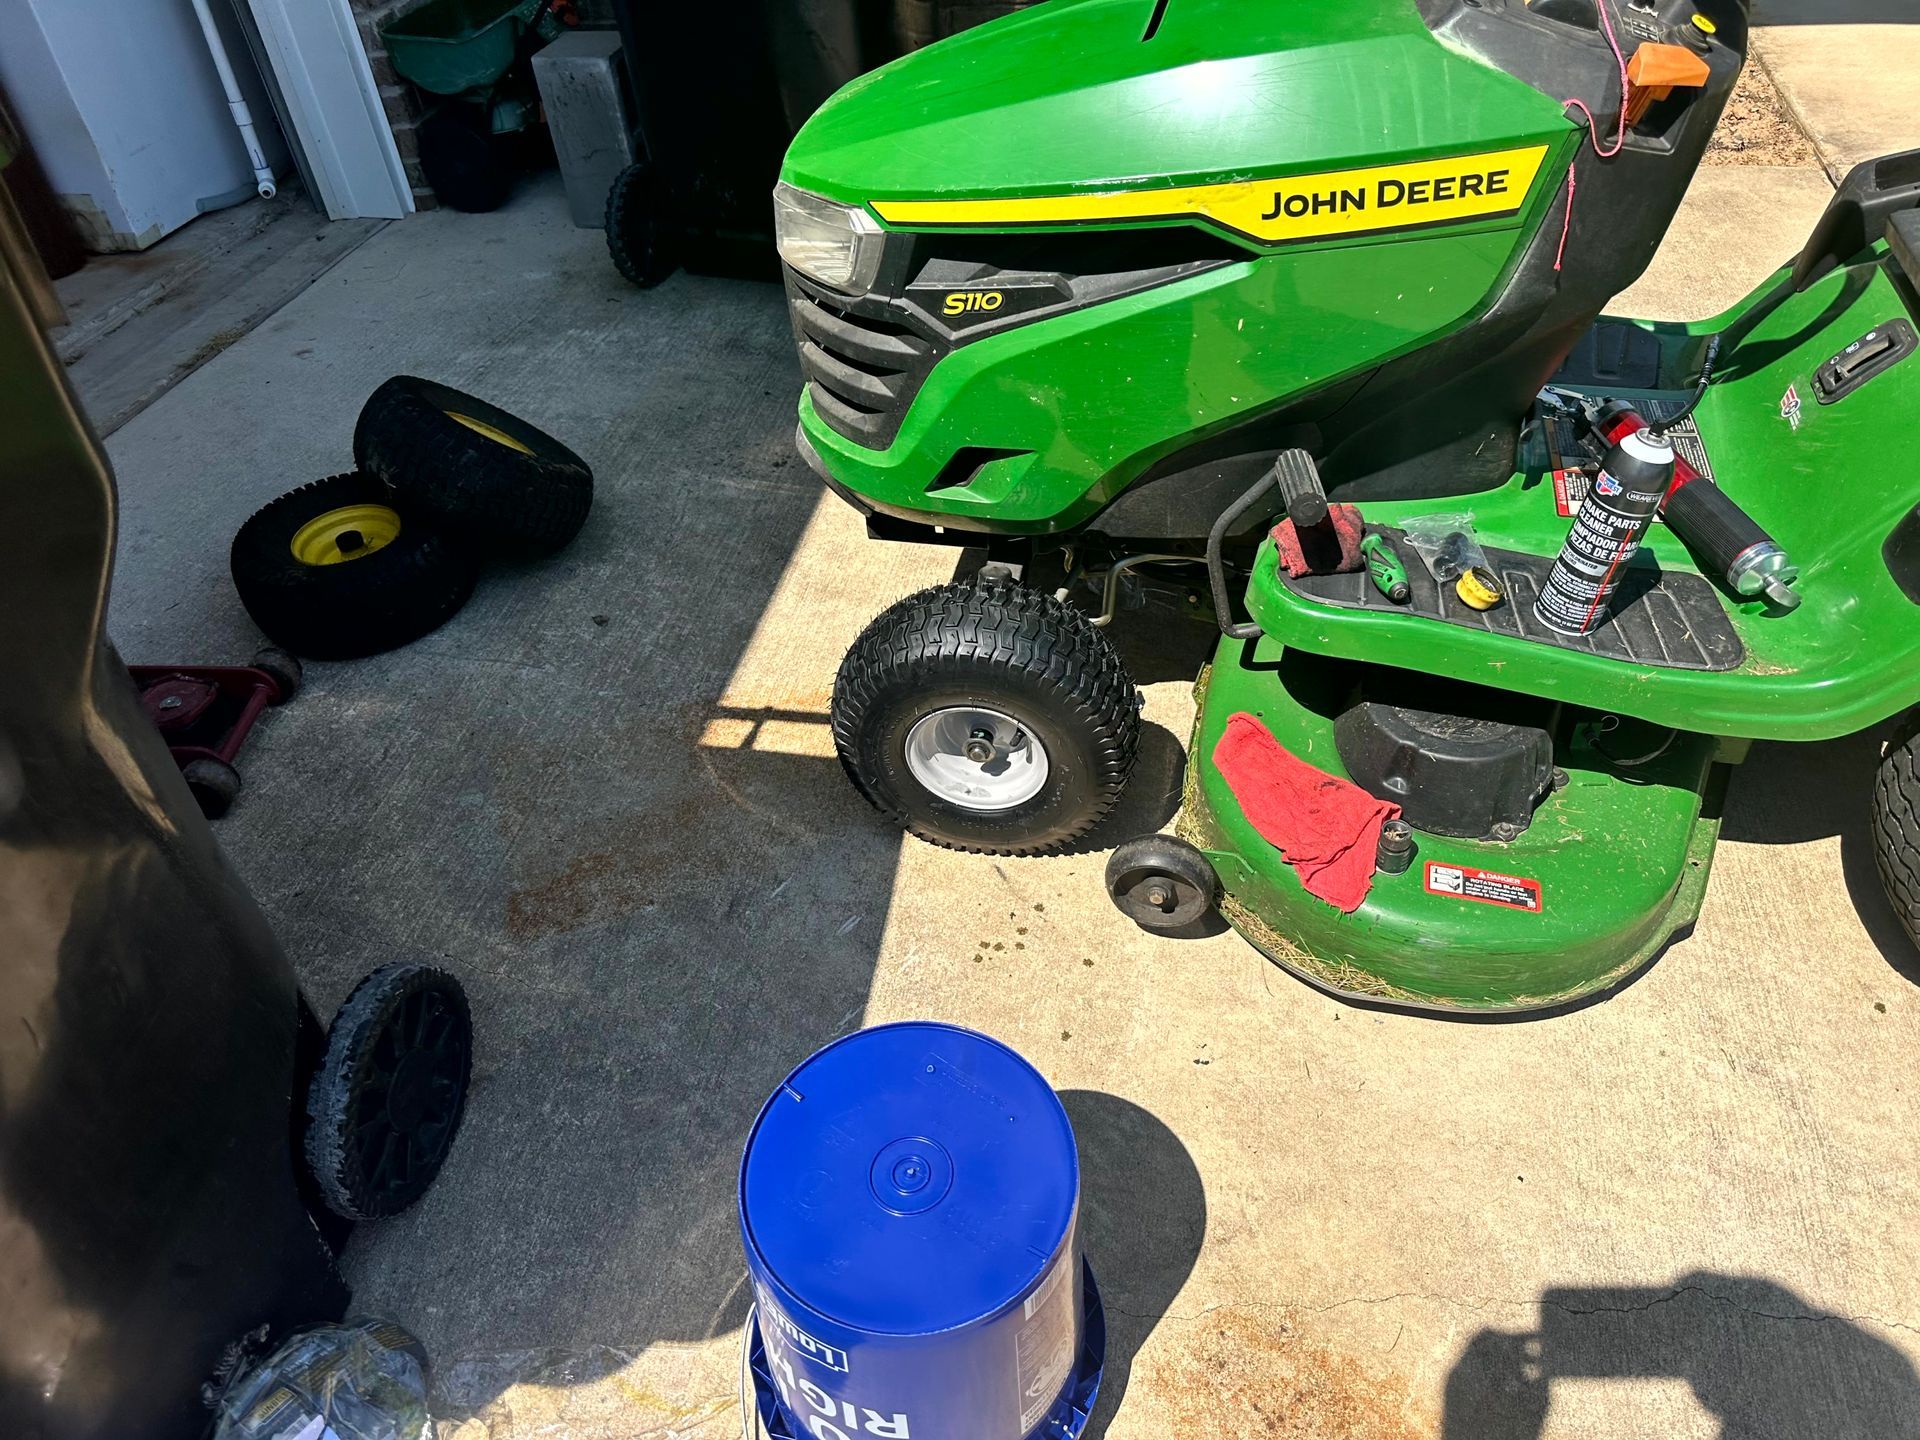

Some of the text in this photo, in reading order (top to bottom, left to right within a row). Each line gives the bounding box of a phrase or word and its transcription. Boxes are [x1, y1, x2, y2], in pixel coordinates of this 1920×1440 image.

[1262, 169, 1509, 220] JOHN DEERE
[943, 292, 1003, 315] S110
[1579, 506, 1614, 536] CLEANER
[1583, 496, 1641, 530] BRAKE PARTS
[1593, 549, 1609, 560] DE
[1470, 878, 1525, 892] ROTATING BLADE
[1486, 873, 1520, 885] DANGER
